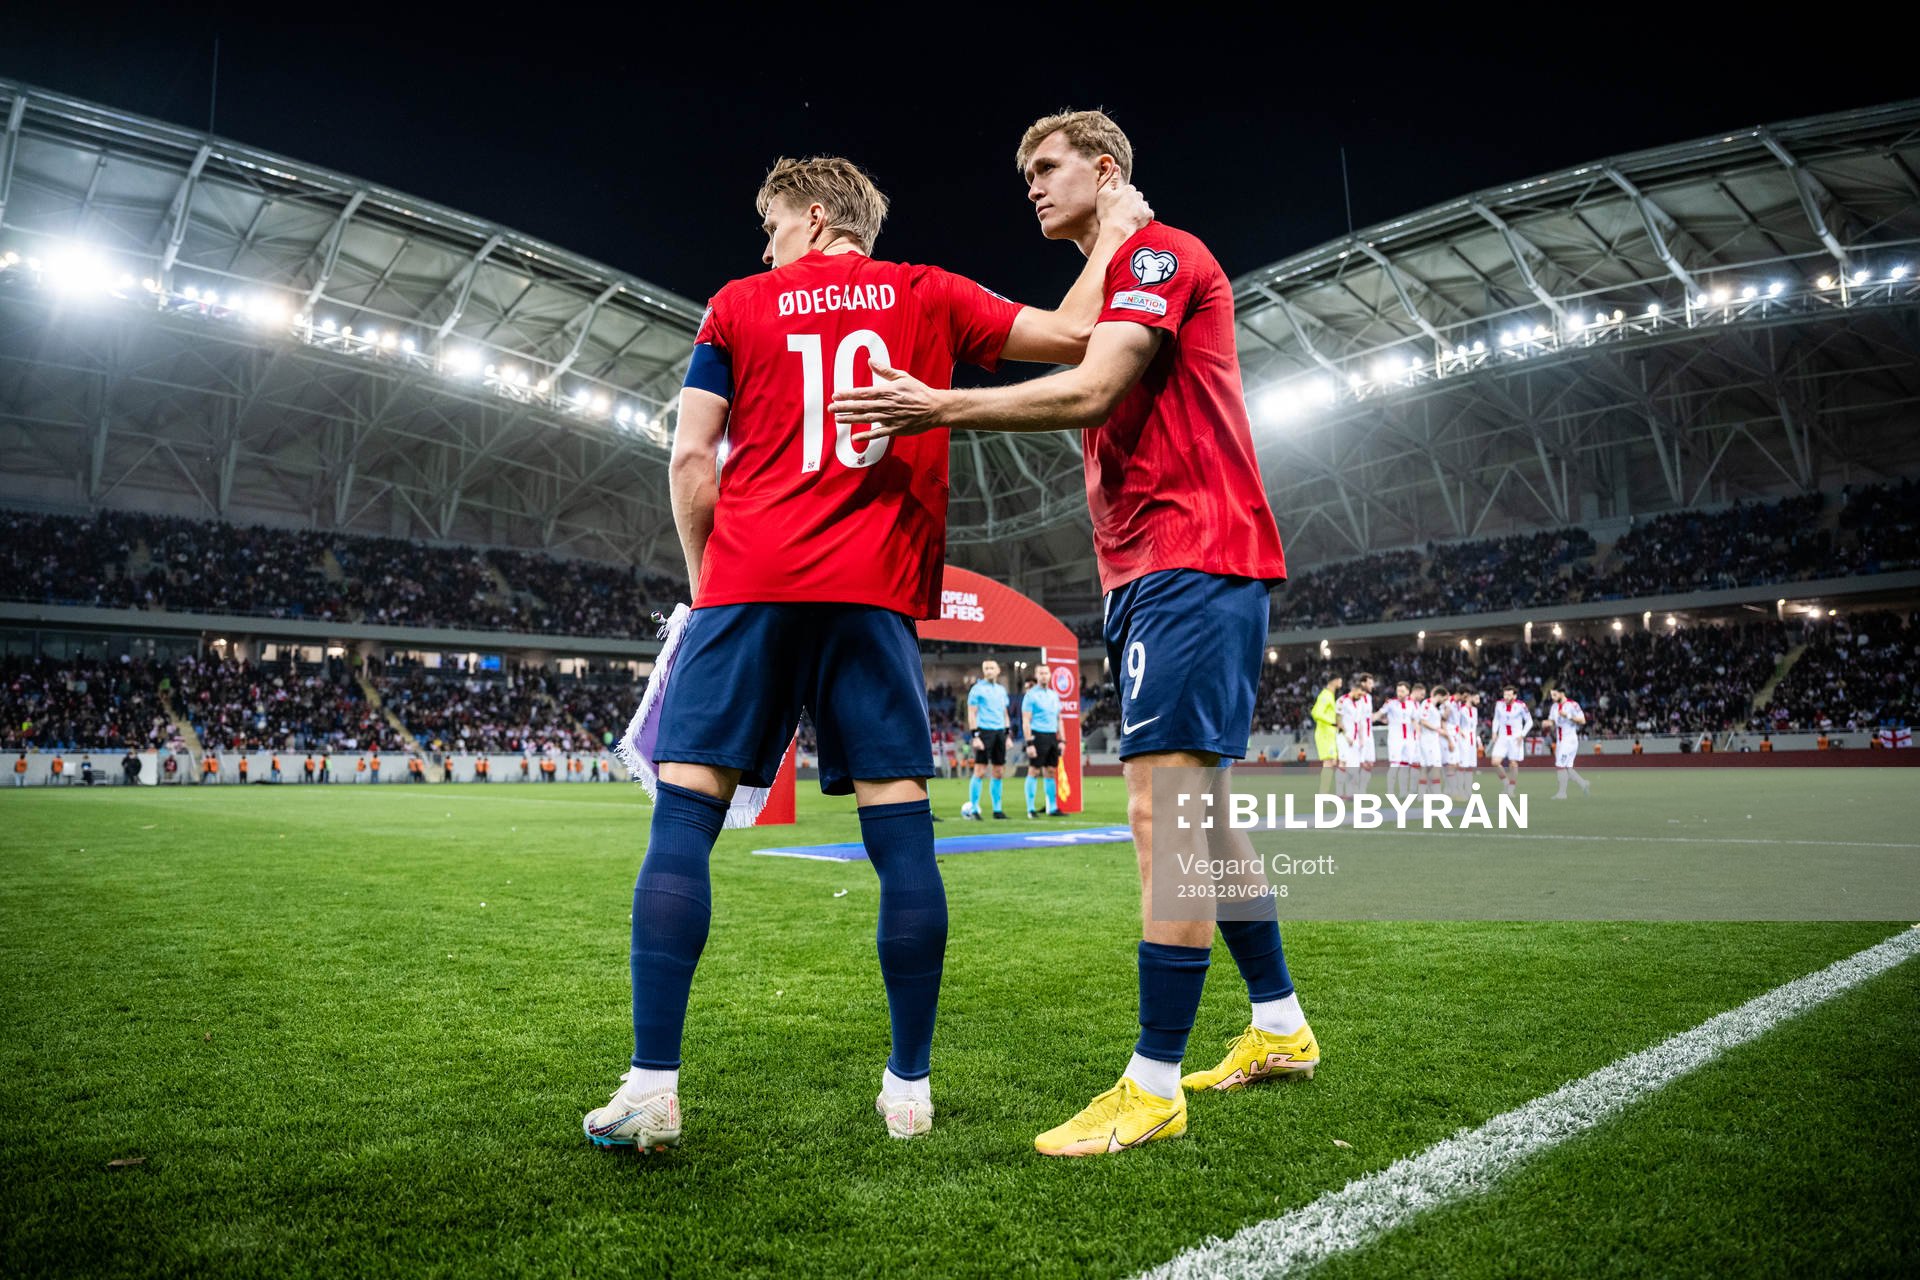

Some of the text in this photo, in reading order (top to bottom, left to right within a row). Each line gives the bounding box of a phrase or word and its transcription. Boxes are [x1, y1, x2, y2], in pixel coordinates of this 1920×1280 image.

[778, 284, 896, 317] ØDEGAARD
[786, 329, 893, 474] 10
[940, 604, 985, 622] LIFIERS
[941, 590, 978, 606] OPEAN
[1127, 641, 1146, 700] 9
